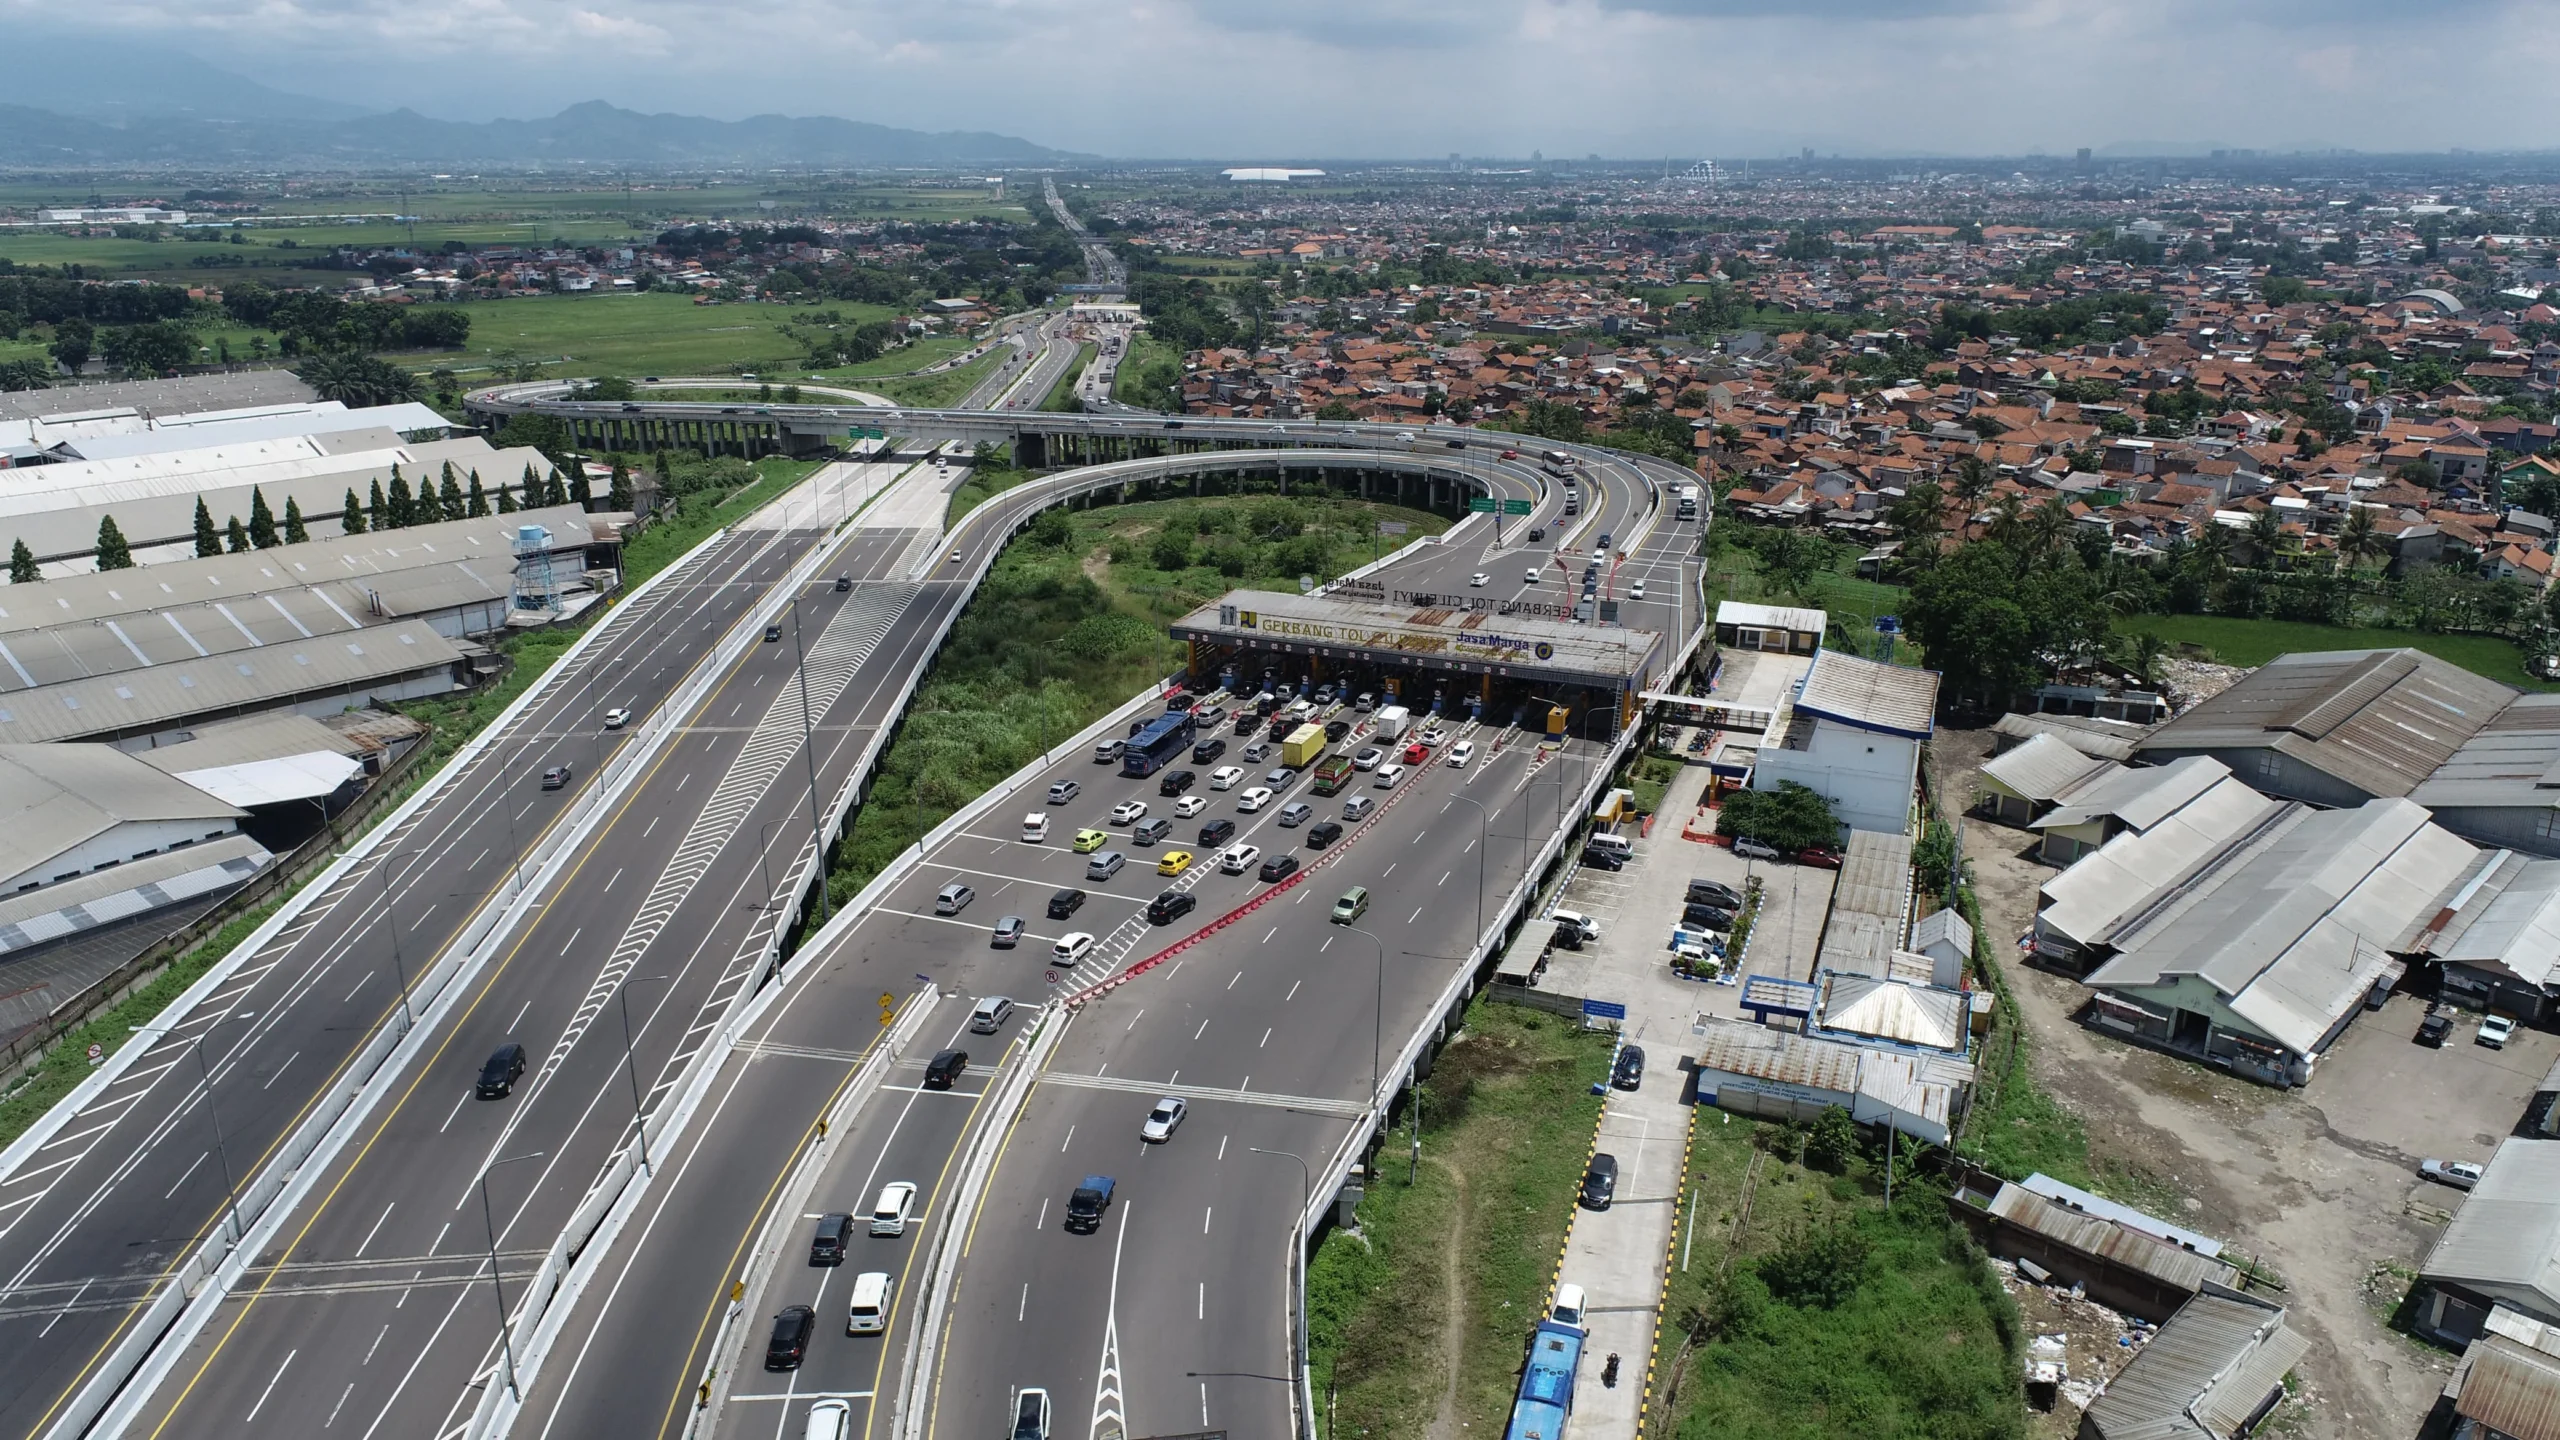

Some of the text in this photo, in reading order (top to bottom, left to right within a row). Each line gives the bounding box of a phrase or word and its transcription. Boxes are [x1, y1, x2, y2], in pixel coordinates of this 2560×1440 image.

[1262, 619, 1333, 638] GERBANG
[1338, 627, 1368, 641] TOL
[1456, 631, 1529, 650] Jasa Marga
